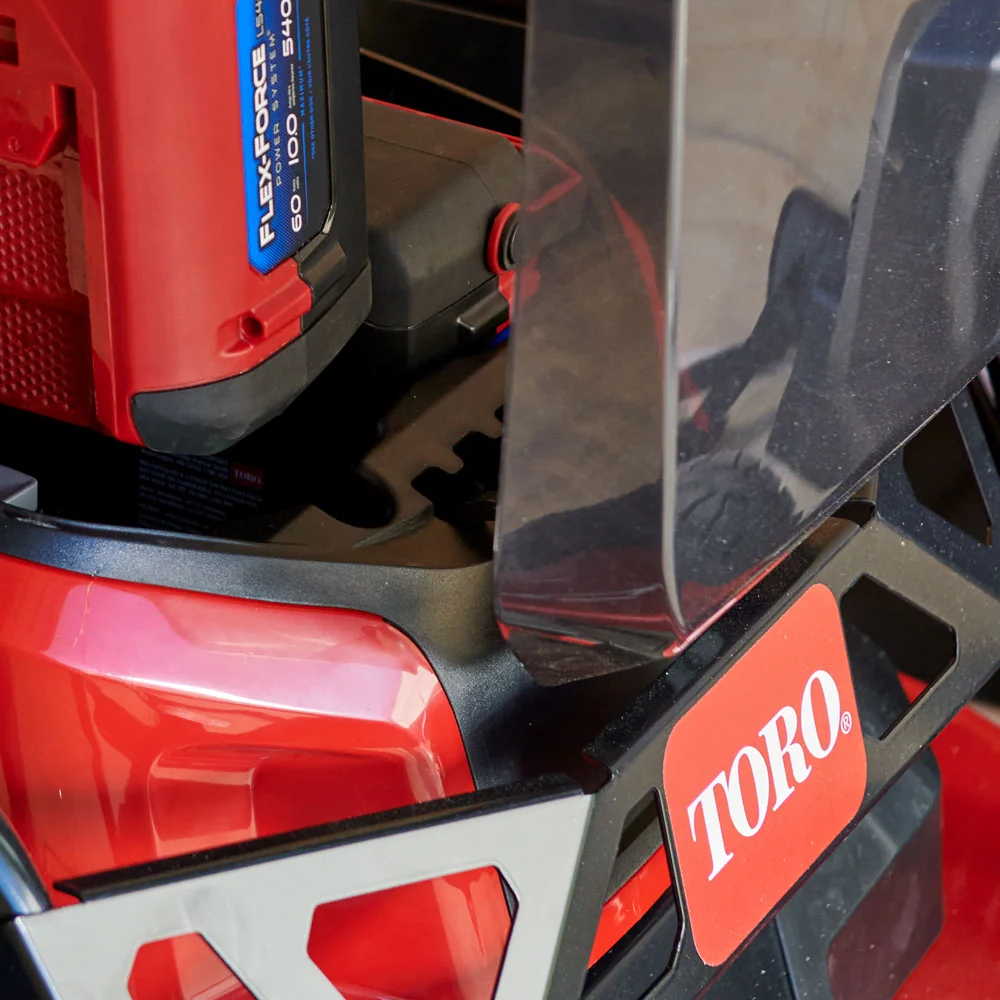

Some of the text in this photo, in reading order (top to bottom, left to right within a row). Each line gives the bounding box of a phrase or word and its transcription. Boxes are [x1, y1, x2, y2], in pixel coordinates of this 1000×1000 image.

[252, 43, 275, 247] FLEX-FORCE
[273, 122, 282, 186] POWER
[286, 113, 299, 165] 10.0
[290, 194, 302, 233] 60
